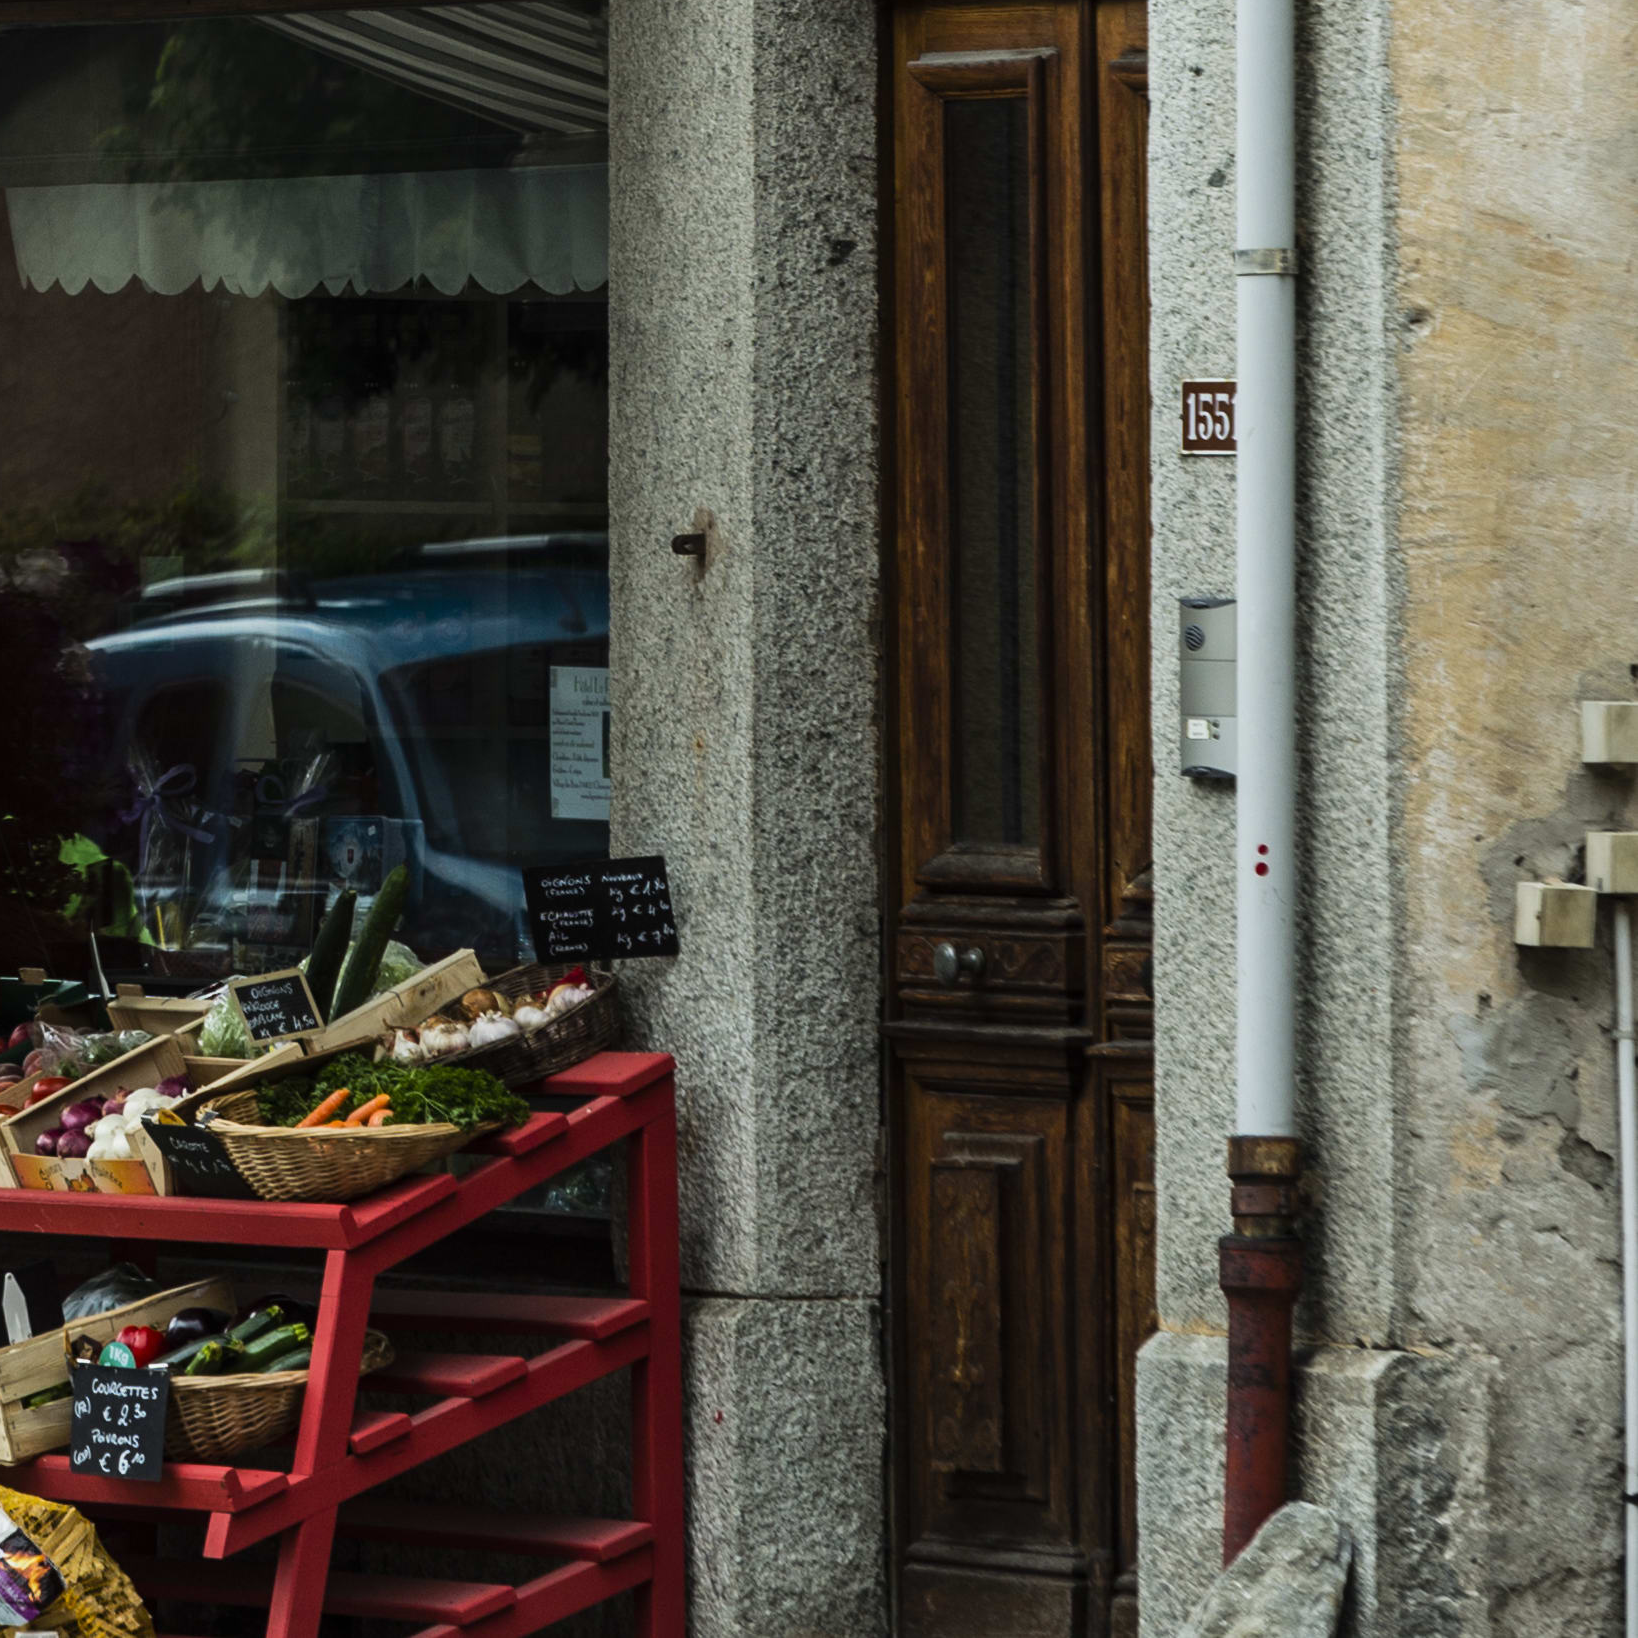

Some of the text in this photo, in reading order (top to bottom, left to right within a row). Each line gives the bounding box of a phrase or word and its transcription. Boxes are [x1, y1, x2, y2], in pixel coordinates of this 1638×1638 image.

[92, 1378, 159, 1399] COURGETTES
[103, 1406, 111, 1421] €
[91, 1428, 139, 1448] POIVRONS
[99, 1453, 111, 1472] €
